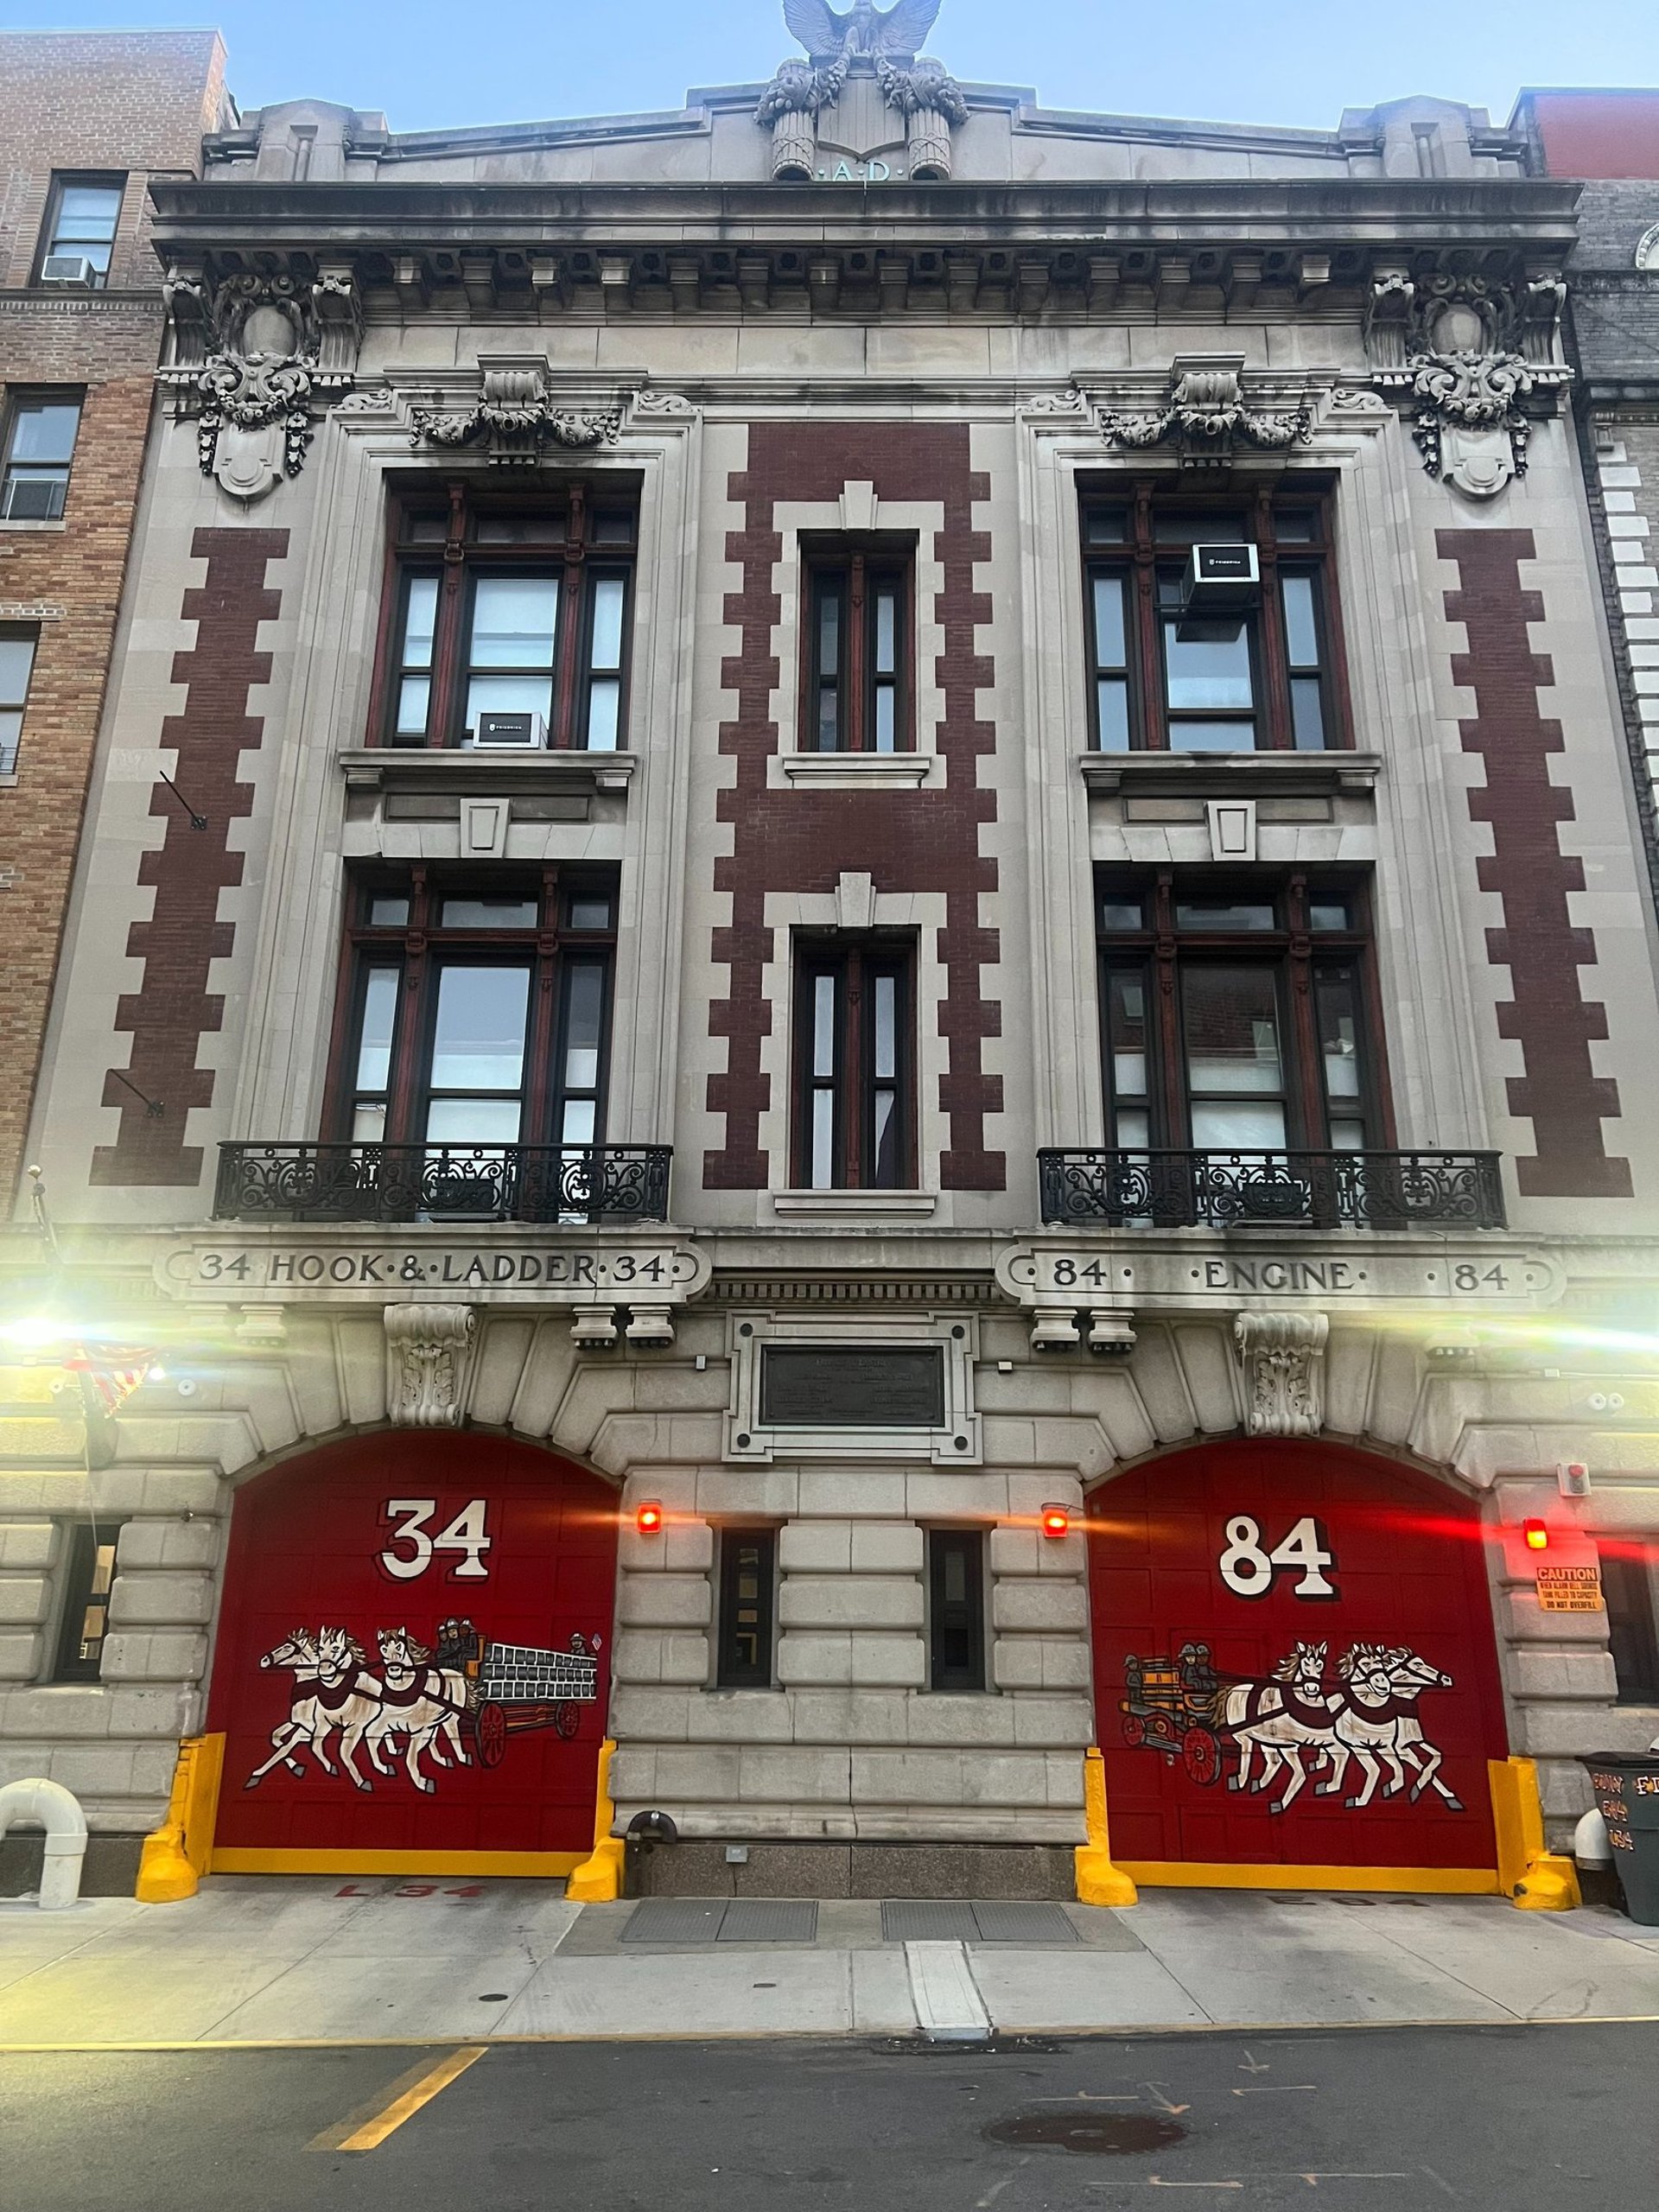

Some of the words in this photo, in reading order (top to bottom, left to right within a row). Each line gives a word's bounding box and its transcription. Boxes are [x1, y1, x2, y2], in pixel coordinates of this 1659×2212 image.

[198, 1253, 251, 1281] 34
[270, 1254, 385, 1281] HOOK
[399, 1254, 427, 1281] &
[442, 1255, 596, 1284] LADDER
[613, 1255, 665, 1282] 34
[1053, 1258, 1107, 1286] 84
[1205, 1260, 1356, 1290] ENGINE
[1455, 1263, 1510, 1291] 84
[378, 1498, 492, 1580] 34
[1219, 1515, 1336, 1597] 84
[1538, 1568, 1597, 1580] CAUTION
